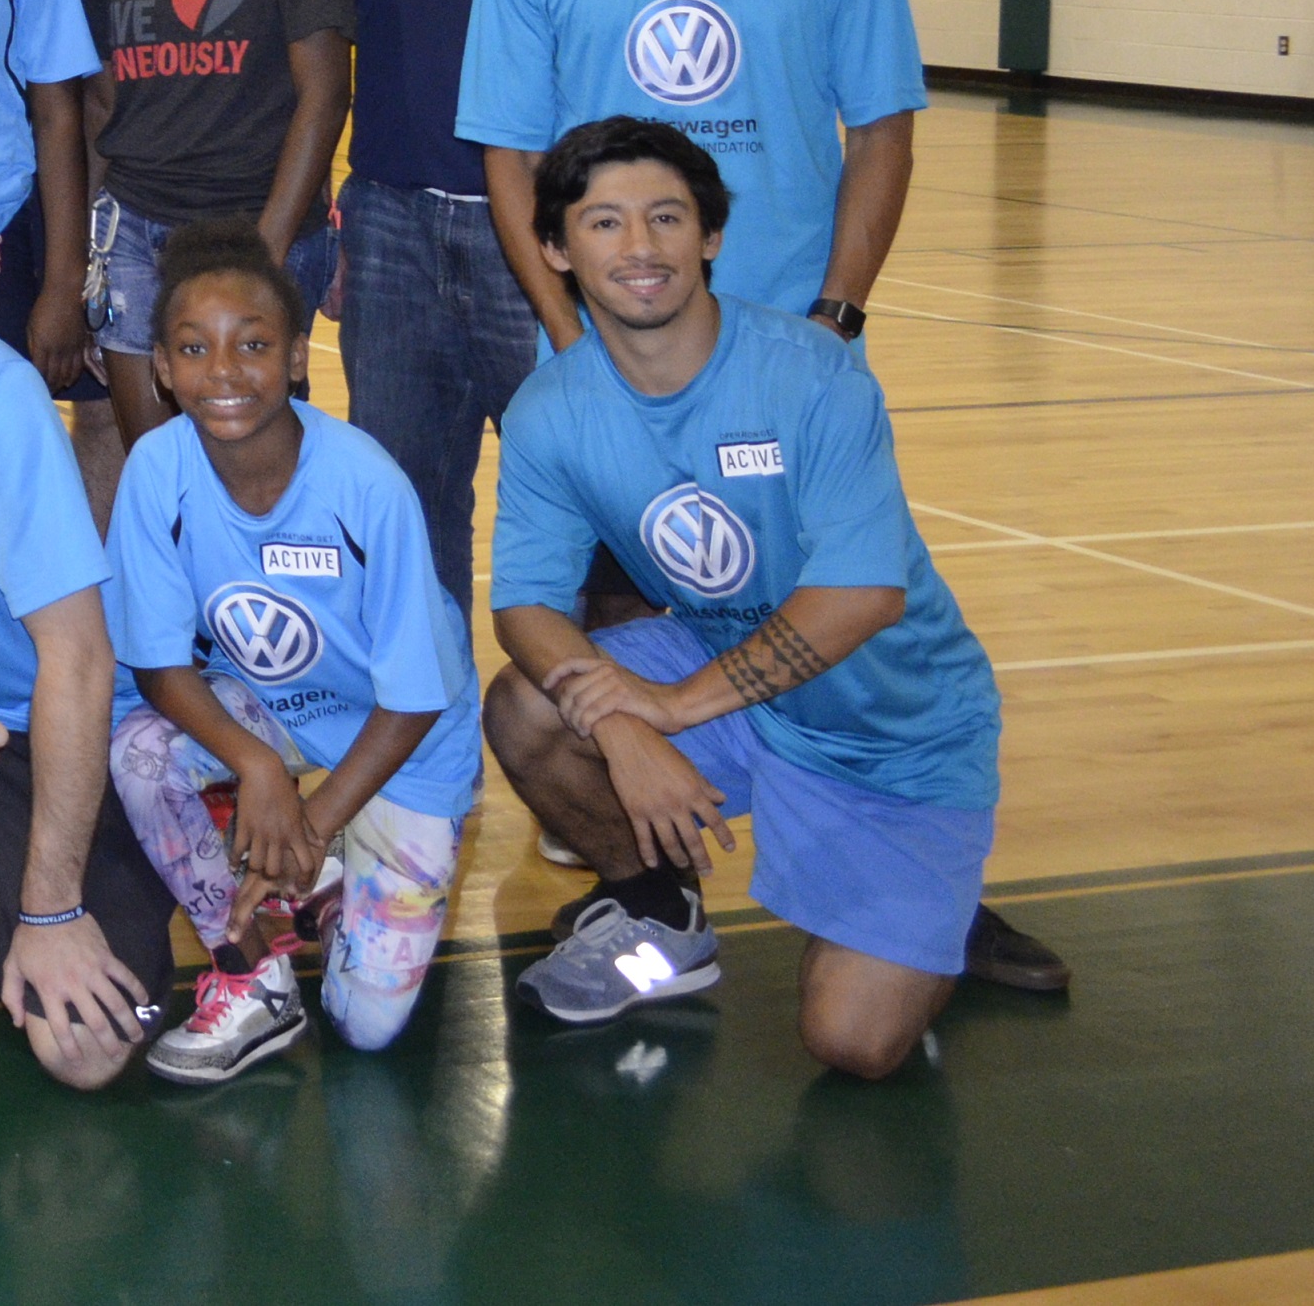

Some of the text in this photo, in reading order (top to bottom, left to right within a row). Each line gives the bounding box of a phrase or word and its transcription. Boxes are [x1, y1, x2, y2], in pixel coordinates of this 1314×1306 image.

[113, 40, 250, 82] NEOUSLY
[726, 446, 783, 469] ACIVE
[269, 549, 336, 570] ACTIVE
[282, 701, 349, 729] NDATION
